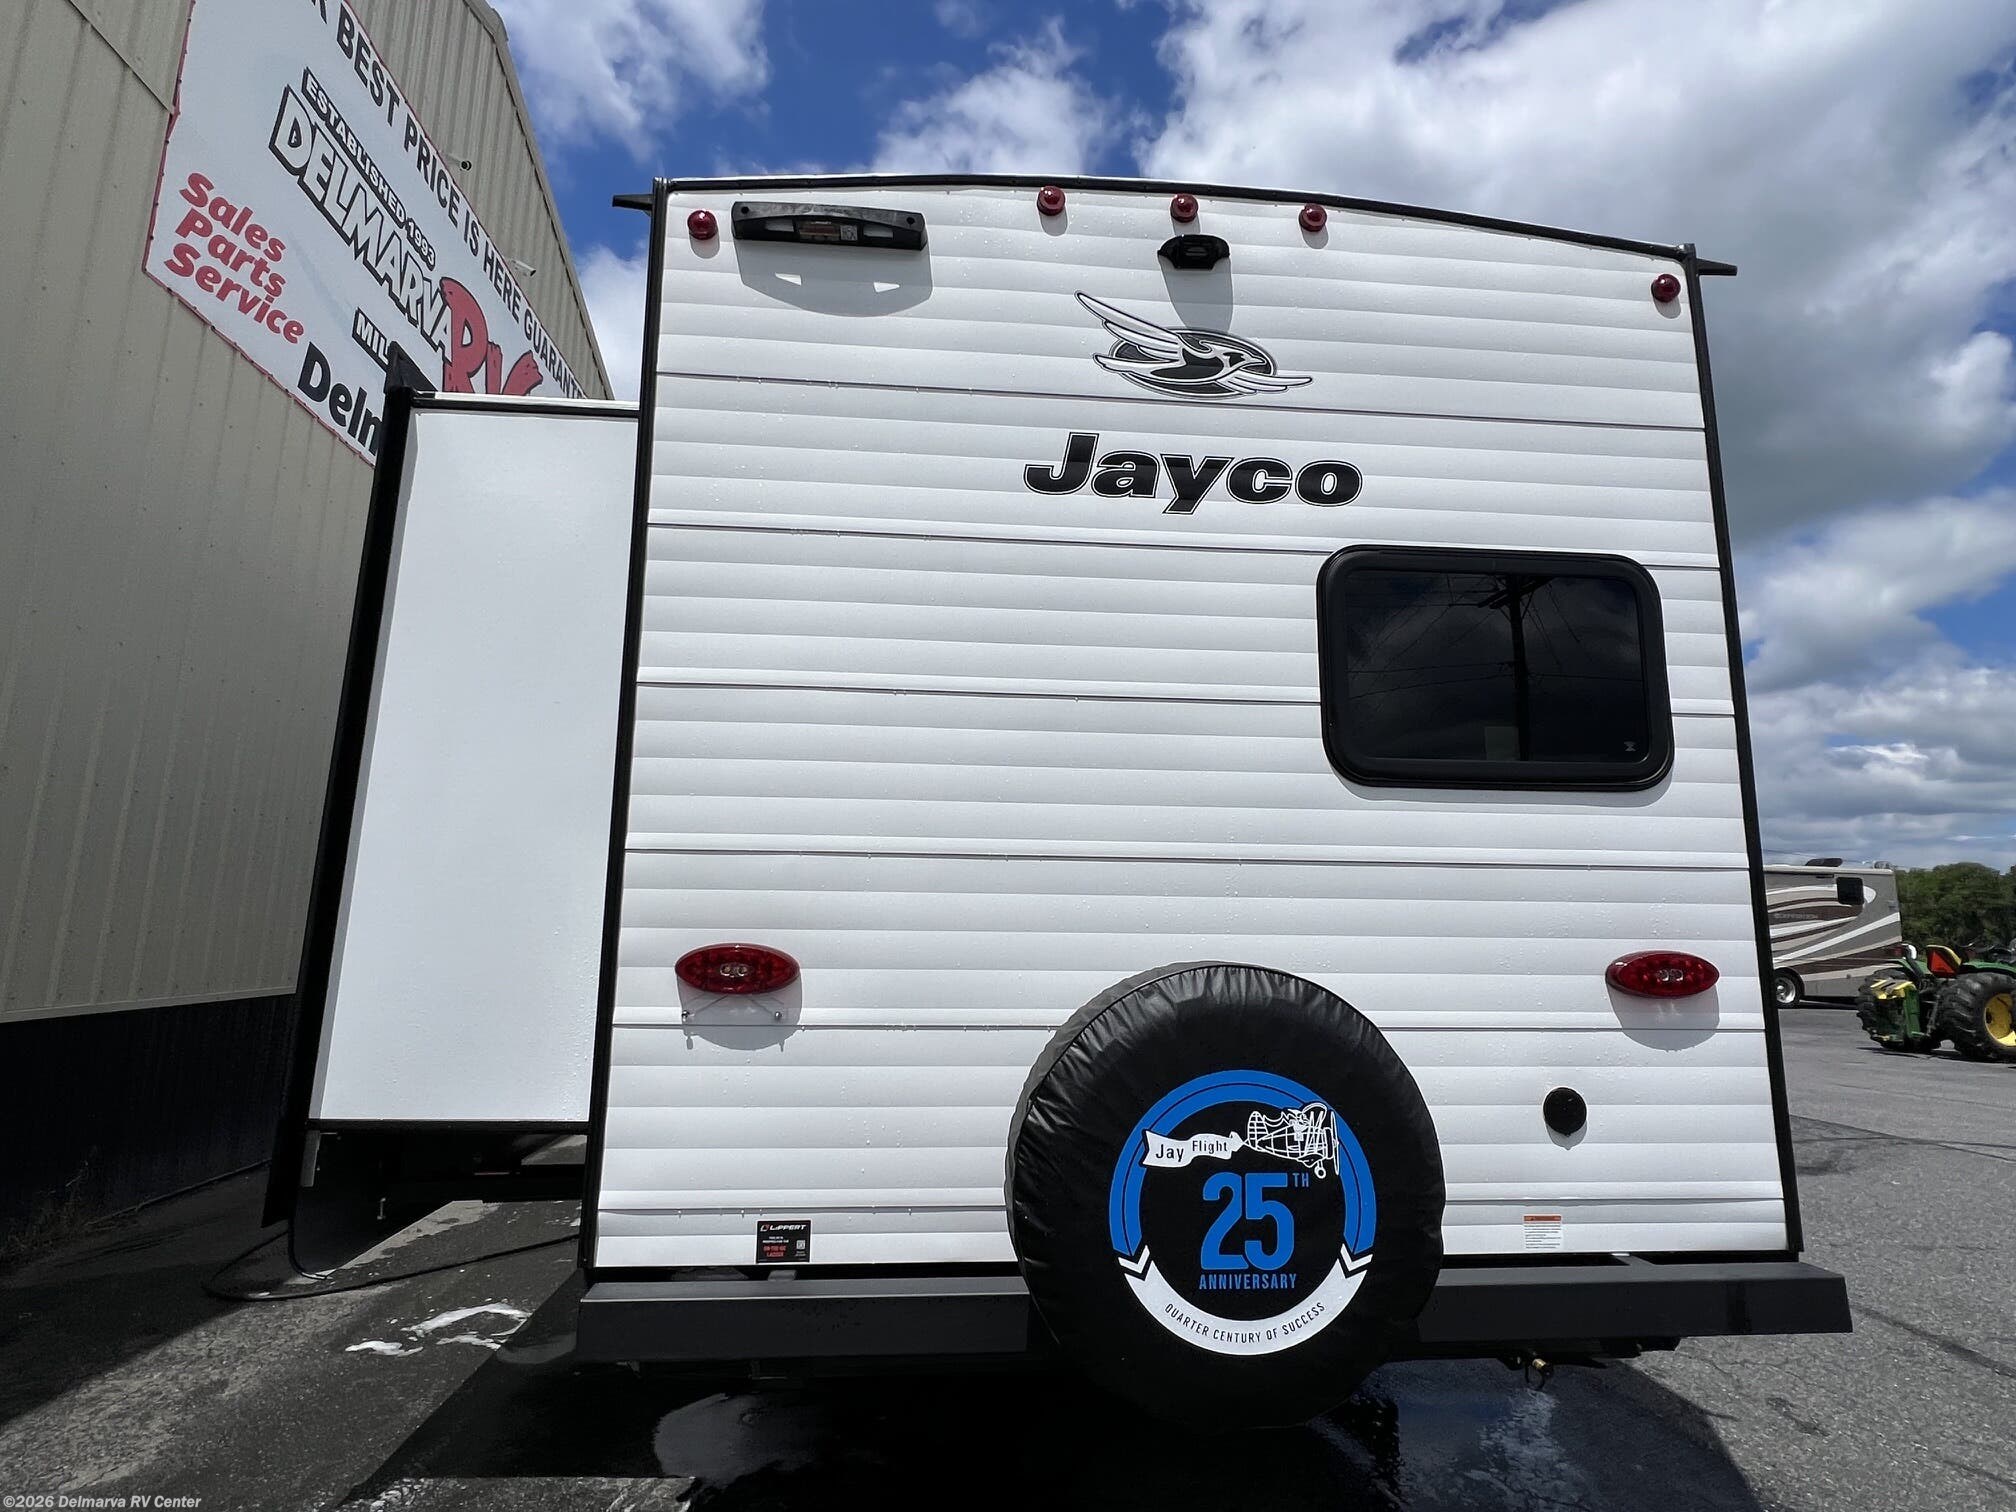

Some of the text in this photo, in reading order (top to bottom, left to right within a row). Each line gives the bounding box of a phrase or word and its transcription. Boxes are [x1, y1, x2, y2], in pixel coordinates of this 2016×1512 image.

[304, 74, 436, 268] ESTABLISHED 1993
[337, 2, 400, 127] BEST
[404, 113, 460, 228] PRICE
[464, 211, 479, 256] IS
[483, 241, 521, 324] HERE
[175, 208, 286, 297] Parts
[179, 173, 286, 262] Sales
[269, 84, 452, 362] DELMARVA
[164, 243, 304, 344] Service
[1023, 432, 1363, 515] Jayco
[1156, 1140, 1227, 1162] Jay Flight
[1165, 1302, 1326, 1344] QUARTER CENTURY OF SUCCESS
[1199, 1274, 1297, 1290] ANNIVERSARY
